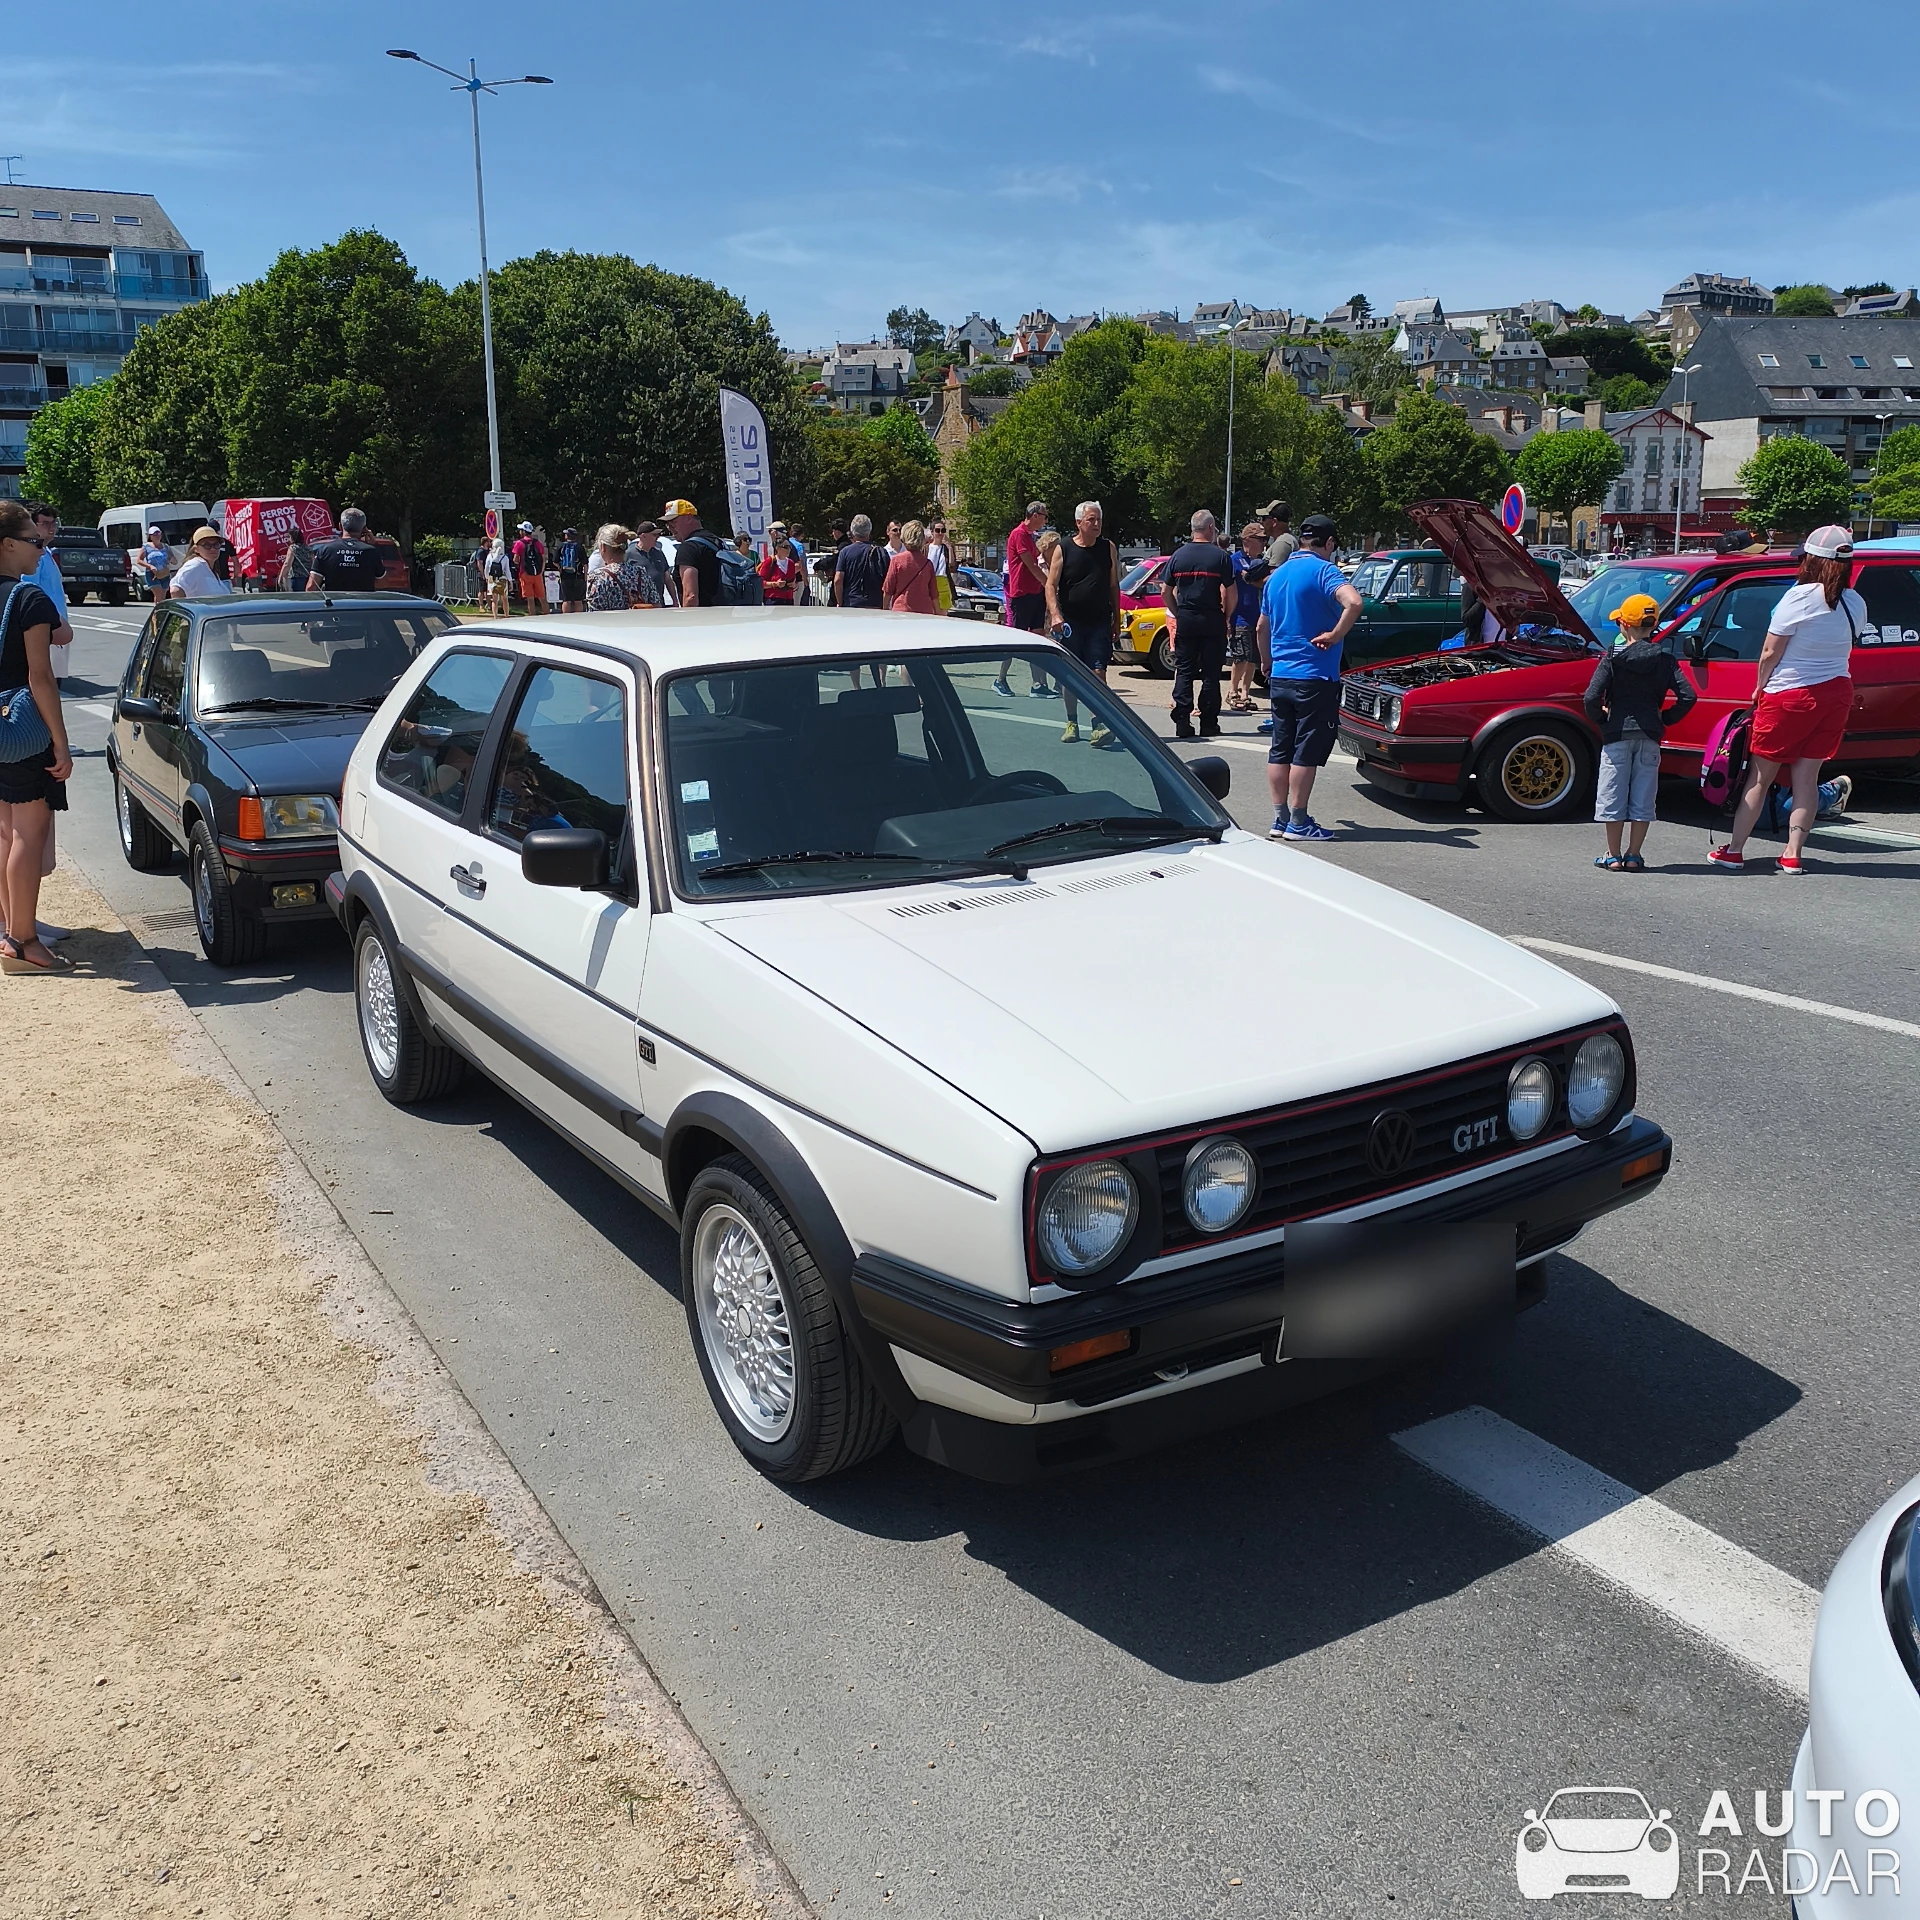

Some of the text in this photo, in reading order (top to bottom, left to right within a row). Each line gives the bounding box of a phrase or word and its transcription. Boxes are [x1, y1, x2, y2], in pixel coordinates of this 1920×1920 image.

[260, 505, 296, 520] PERROS
[262, 513, 300, 536] BOX
[235, 518, 254, 554] BOX
[1453, 1115, 1499, 1153] GTI
